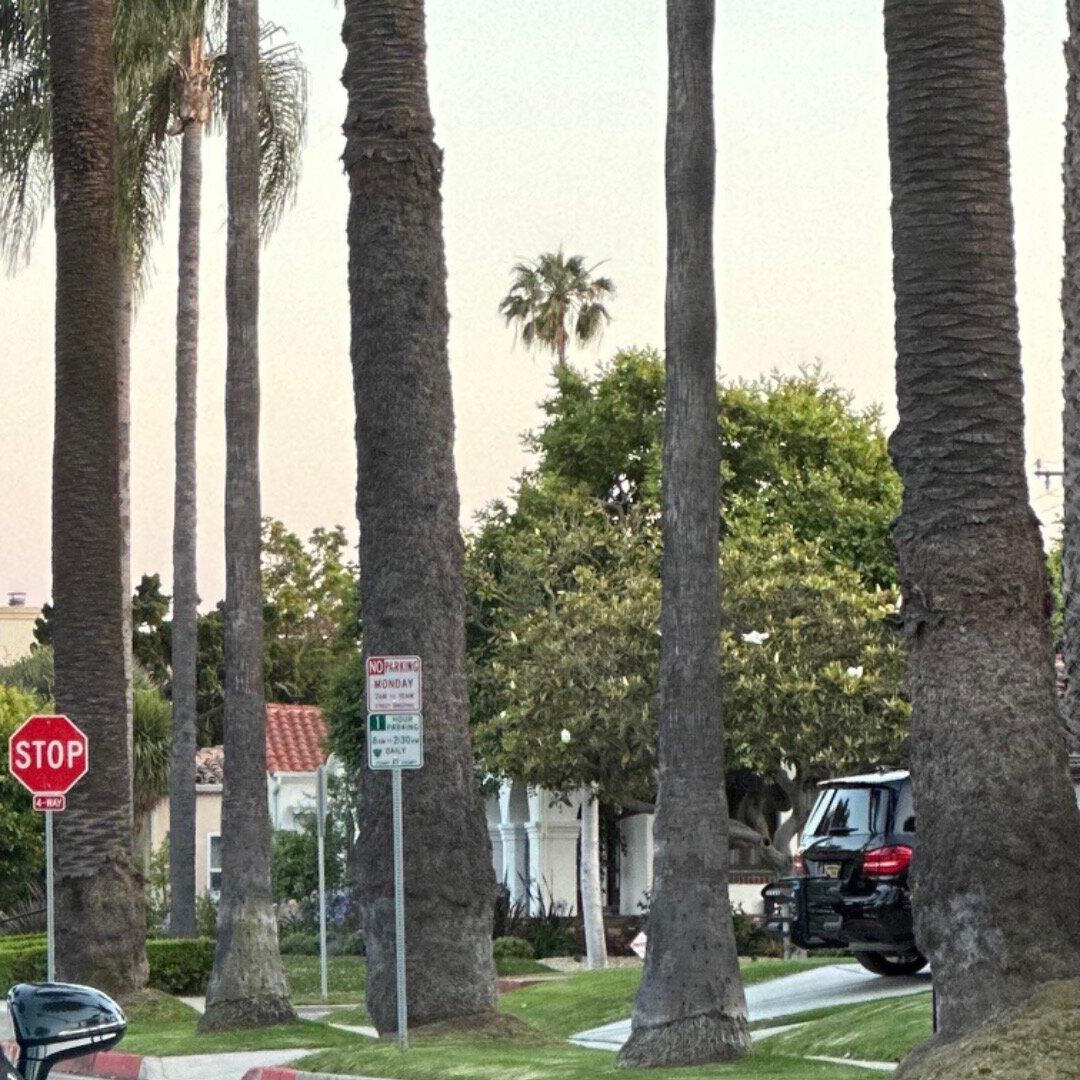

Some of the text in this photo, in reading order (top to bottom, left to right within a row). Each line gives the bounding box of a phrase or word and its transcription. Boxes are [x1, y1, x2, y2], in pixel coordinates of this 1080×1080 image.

[369, 660, 420, 673] NO PARKING
[374, 679, 414, 689] MONDAY
[15, 740, 84, 769] STOP
[36, 798, 62, 808] 4-WAY
